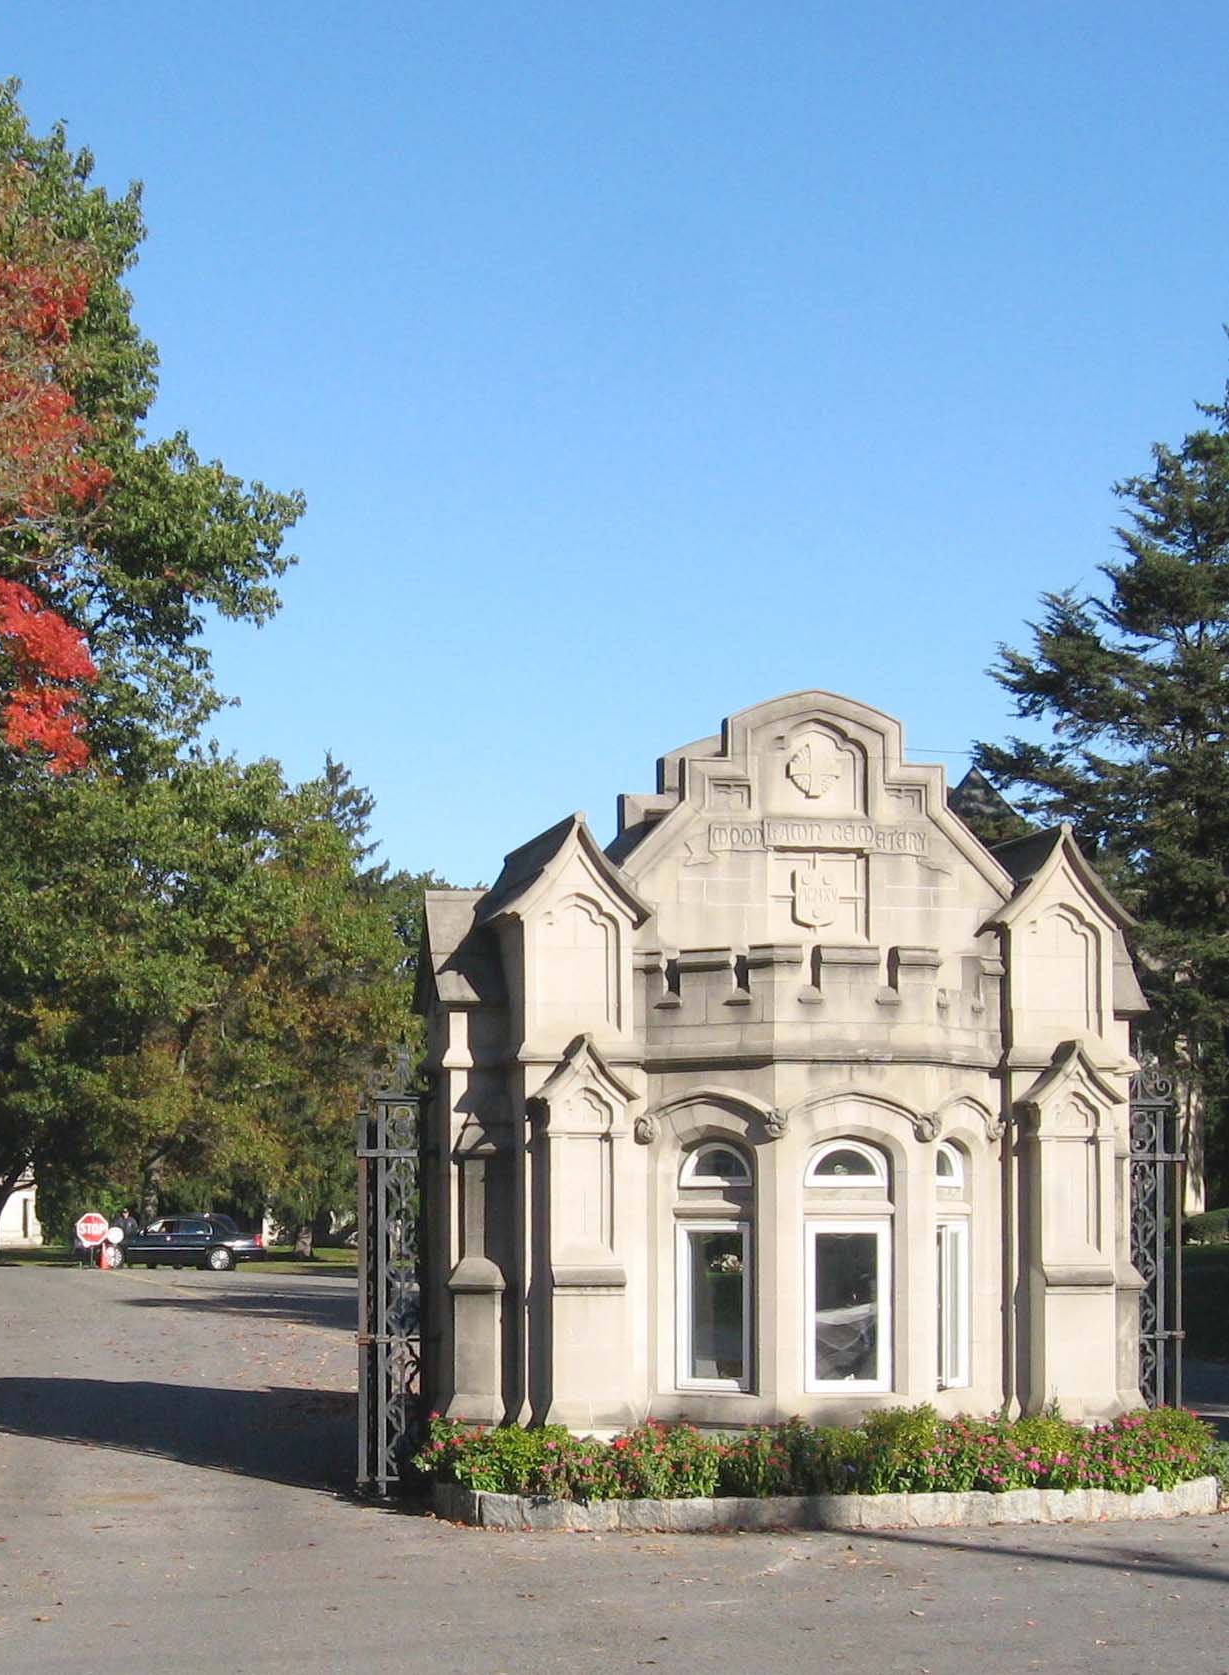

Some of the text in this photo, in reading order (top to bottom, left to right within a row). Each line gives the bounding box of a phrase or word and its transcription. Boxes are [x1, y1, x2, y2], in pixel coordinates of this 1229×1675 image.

[712, 823, 927, 850] WOODLAWN CEMETERY
[79, 1222, 105, 1235] STOP
